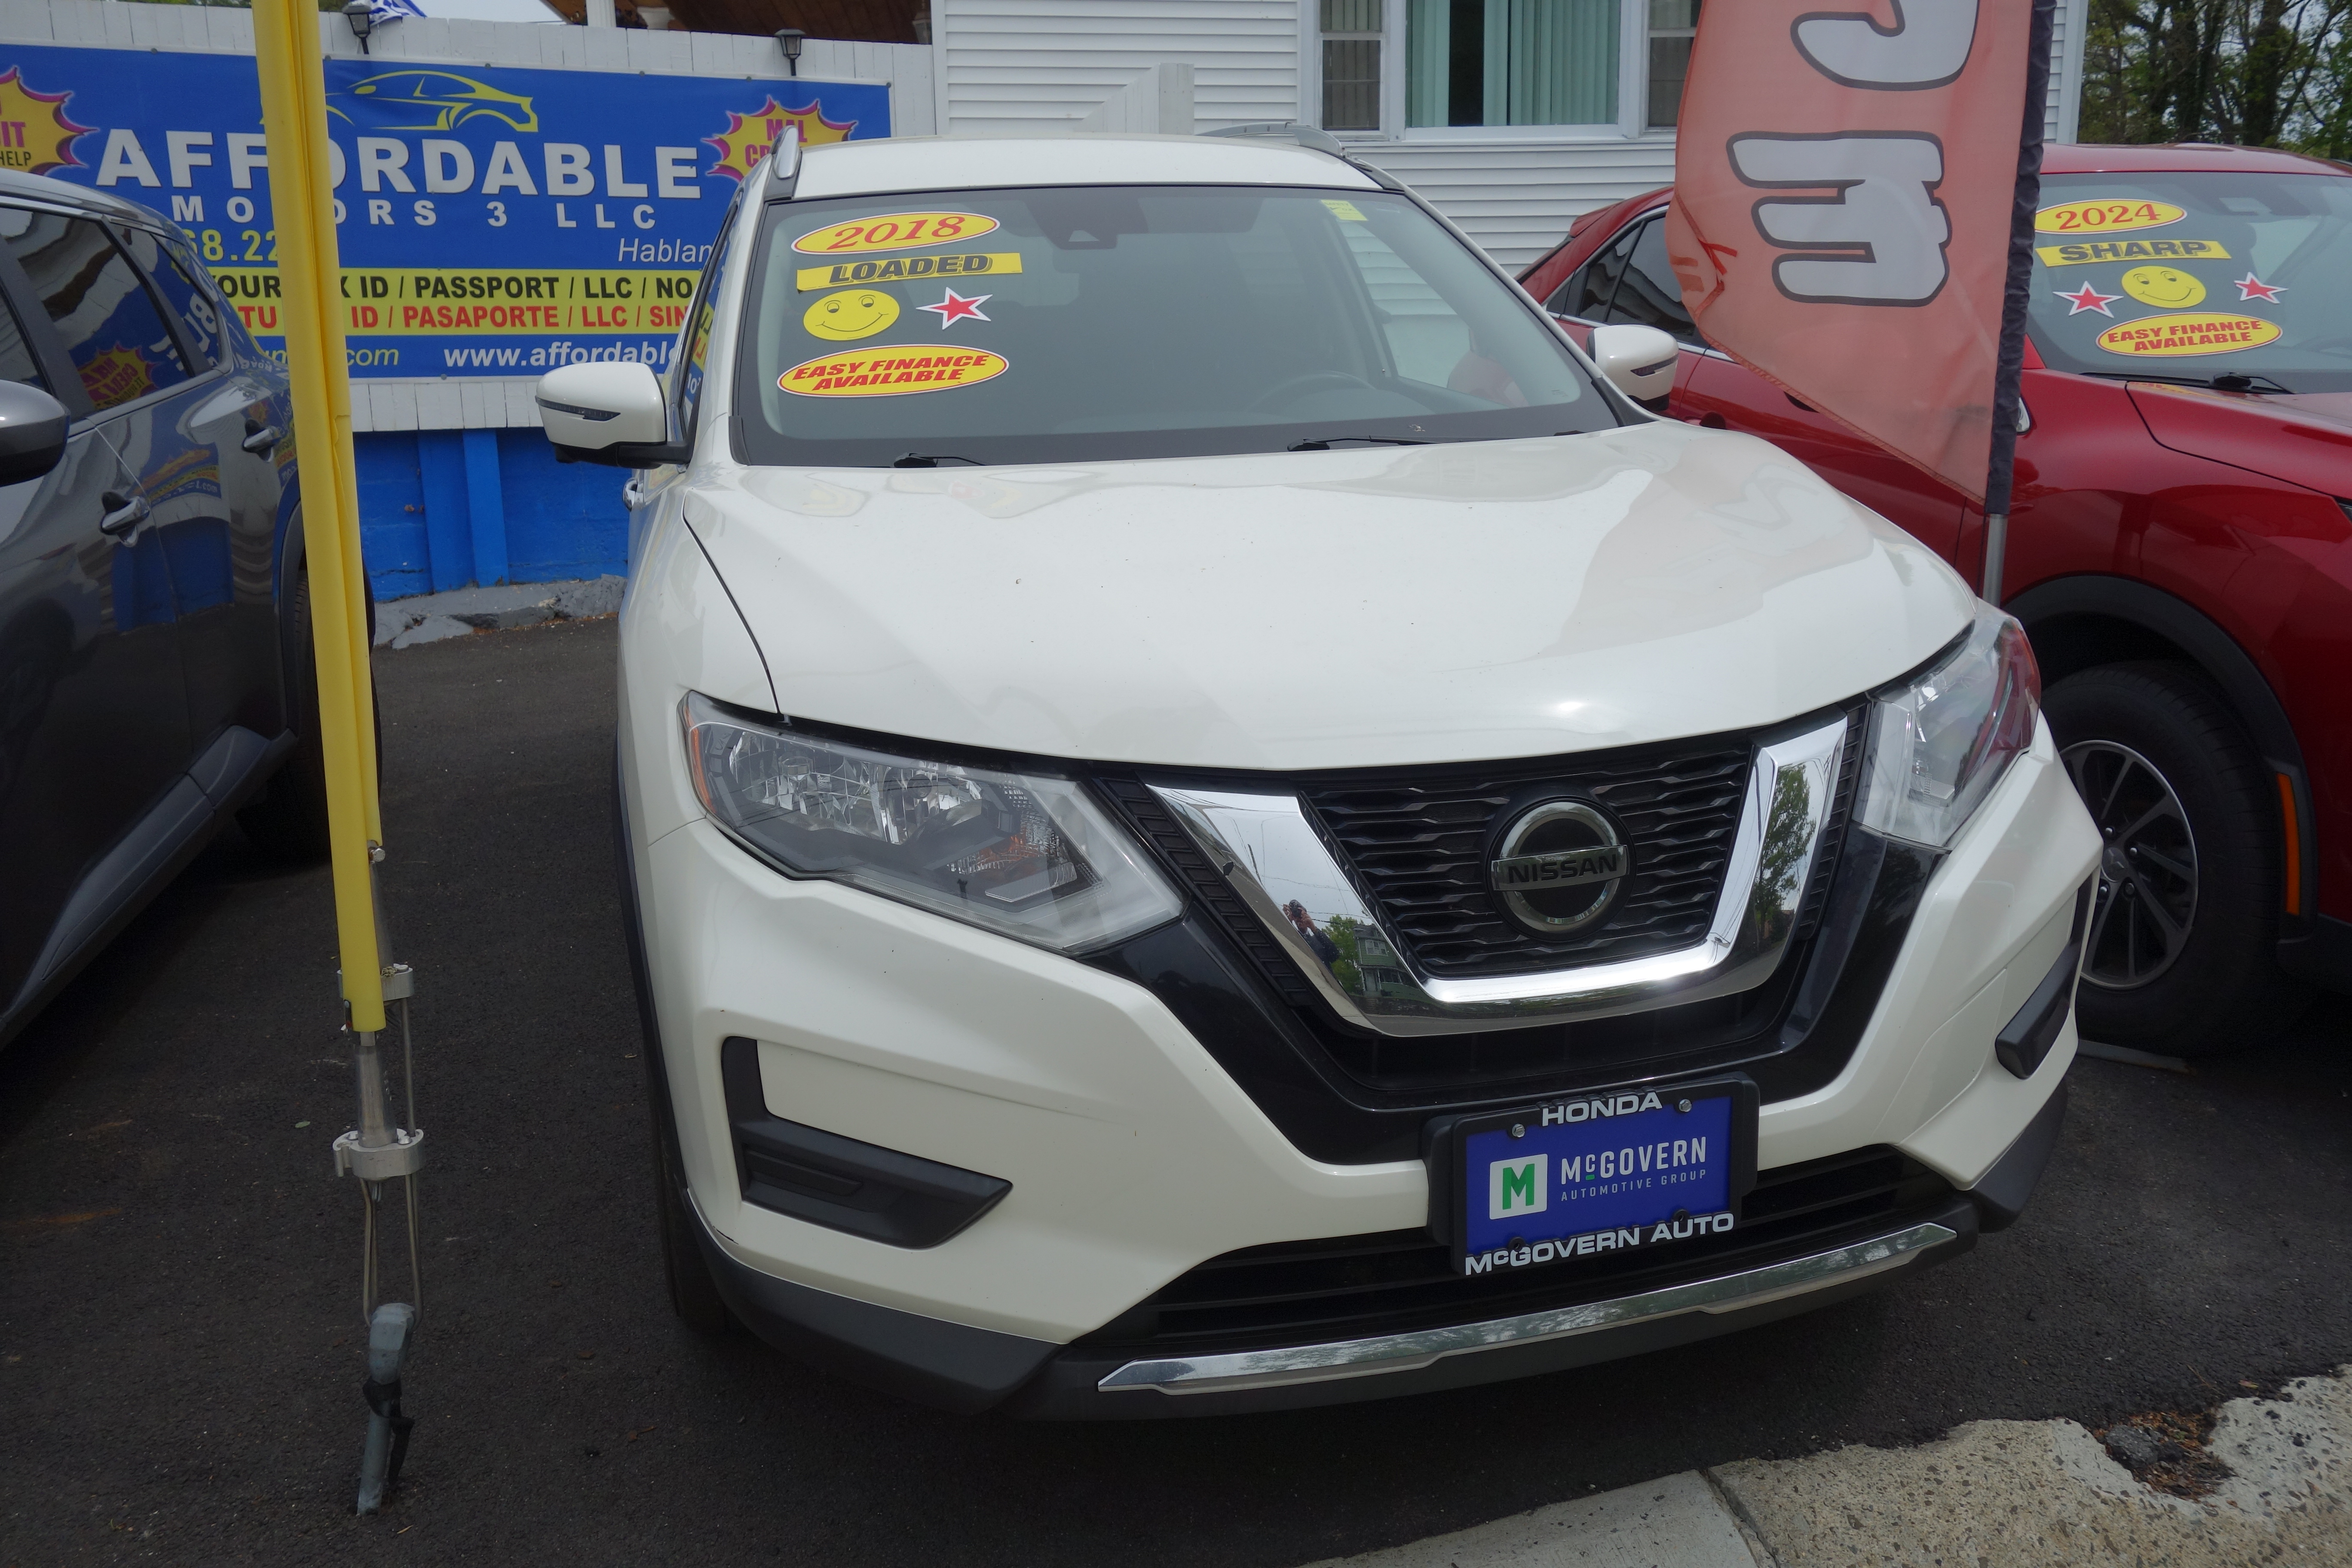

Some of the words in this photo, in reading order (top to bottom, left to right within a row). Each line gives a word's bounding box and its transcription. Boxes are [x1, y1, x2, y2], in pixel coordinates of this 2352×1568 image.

[95, 128, 701, 199] AFFRDABLE
[171, 195, 437, 227] MORS
[488, 201, 508, 227] 3
[2055, 203, 2162, 230] 2024
[827, 216, 965, 250] 2018
[2058, 241, 2211, 262] SHARP
[829, 254, 992, 285] LOADED
[211, 274, 282, 299] OUR
[360, 276, 389, 298] ID
[414, 276, 559, 299] PASSPORT
[584, 277, 633, 299] LLC
[656, 277, 693, 299] NO
[237, 306, 277, 329] TU
[351, 306, 378, 328] ID
[402, 306, 559, 328] PASAPORTE
[582, 306, 628, 327] LLC
[2107, 326, 2163, 343] EASY
[2169, 320, 2263, 336] FINANCE
[444, 341, 676, 367] www.affordabl
[2133, 331, 2253, 352] AVAILABLE
[792, 361, 866, 380] EASY
[868, 355, 990, 372] FINANCE
[812, 368, 965, 392] AVAILABLE
[1508, 854, 1617, 884] NISSAN
[1542, 1091, 1662, 1127] HONDA
[1502, 1163, 1535, 1210] M
[1561, 1178, 1652, 1202] AUTOMOTIVE
[1661, 1169, 1706, 1185] GROUP
[1650, 1213, 1734, 1243] AUTO
